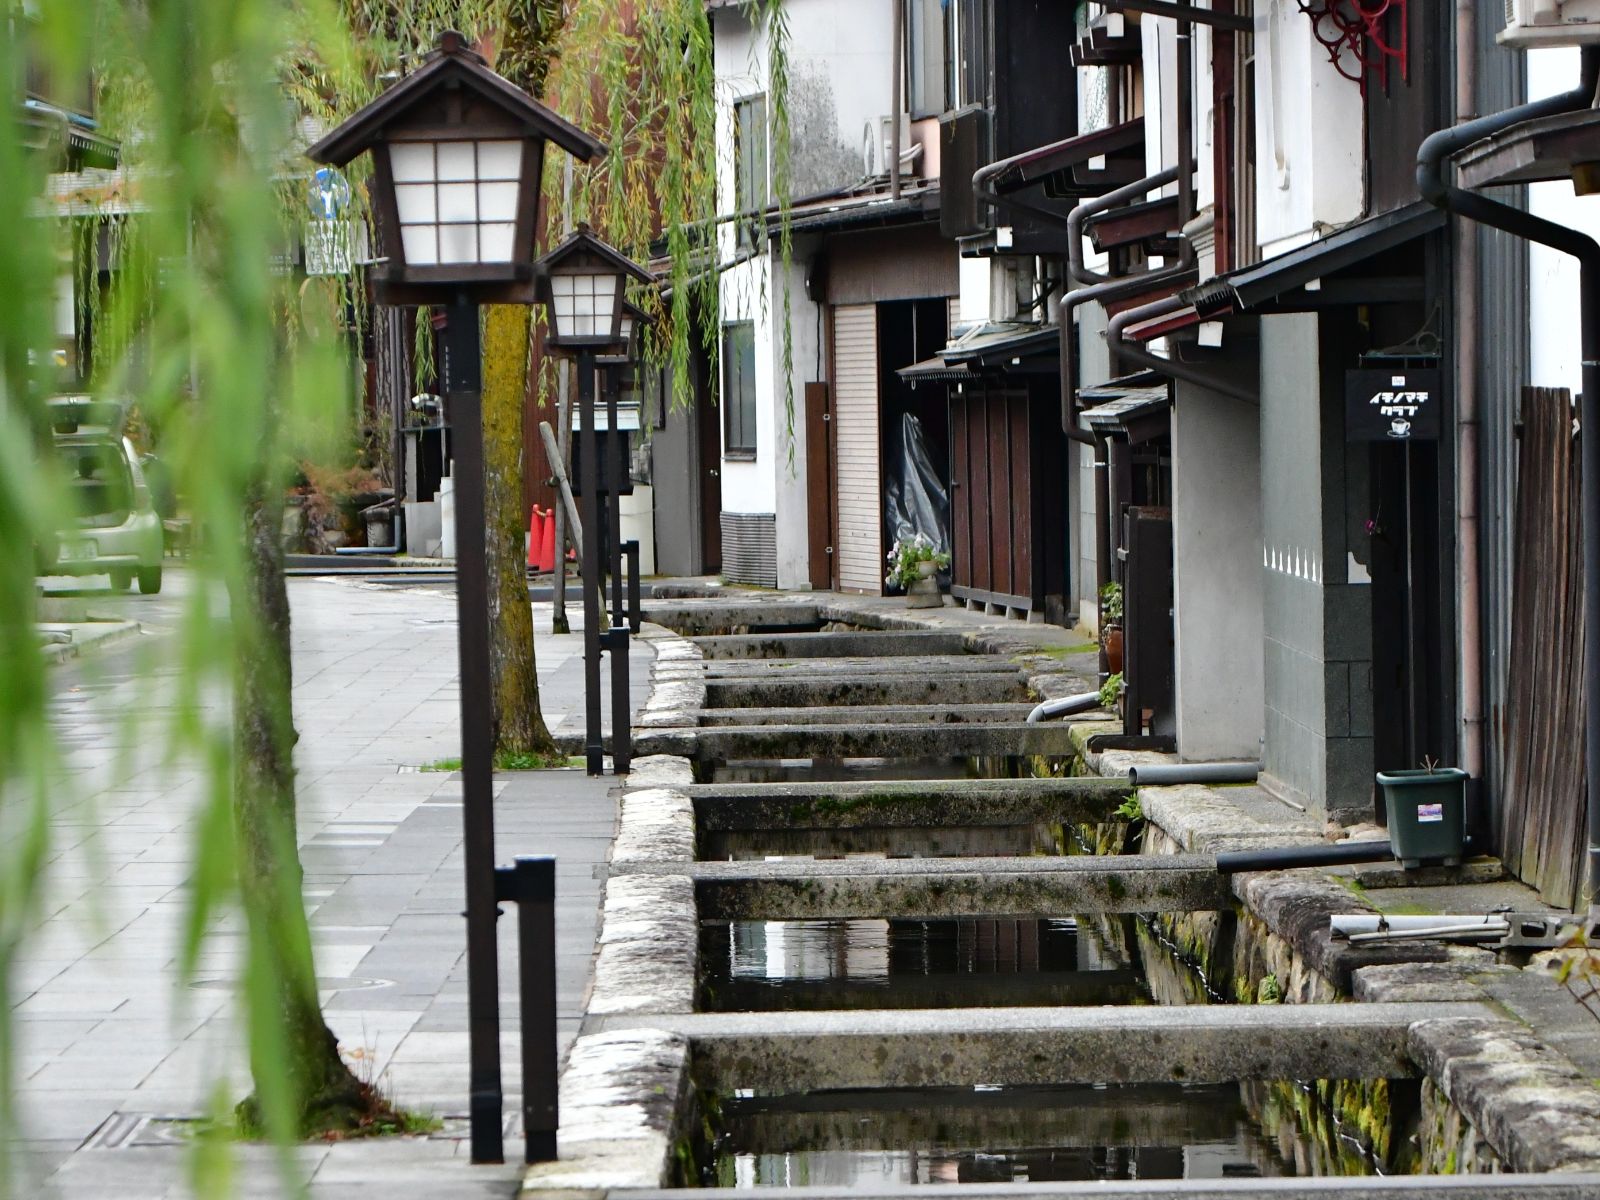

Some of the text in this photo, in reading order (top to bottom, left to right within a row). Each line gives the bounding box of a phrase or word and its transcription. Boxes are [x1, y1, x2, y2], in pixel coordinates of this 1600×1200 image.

[1369, 391, 1429, 404] イチノマチ
[1380, 405, 1419, 416] クラブ
